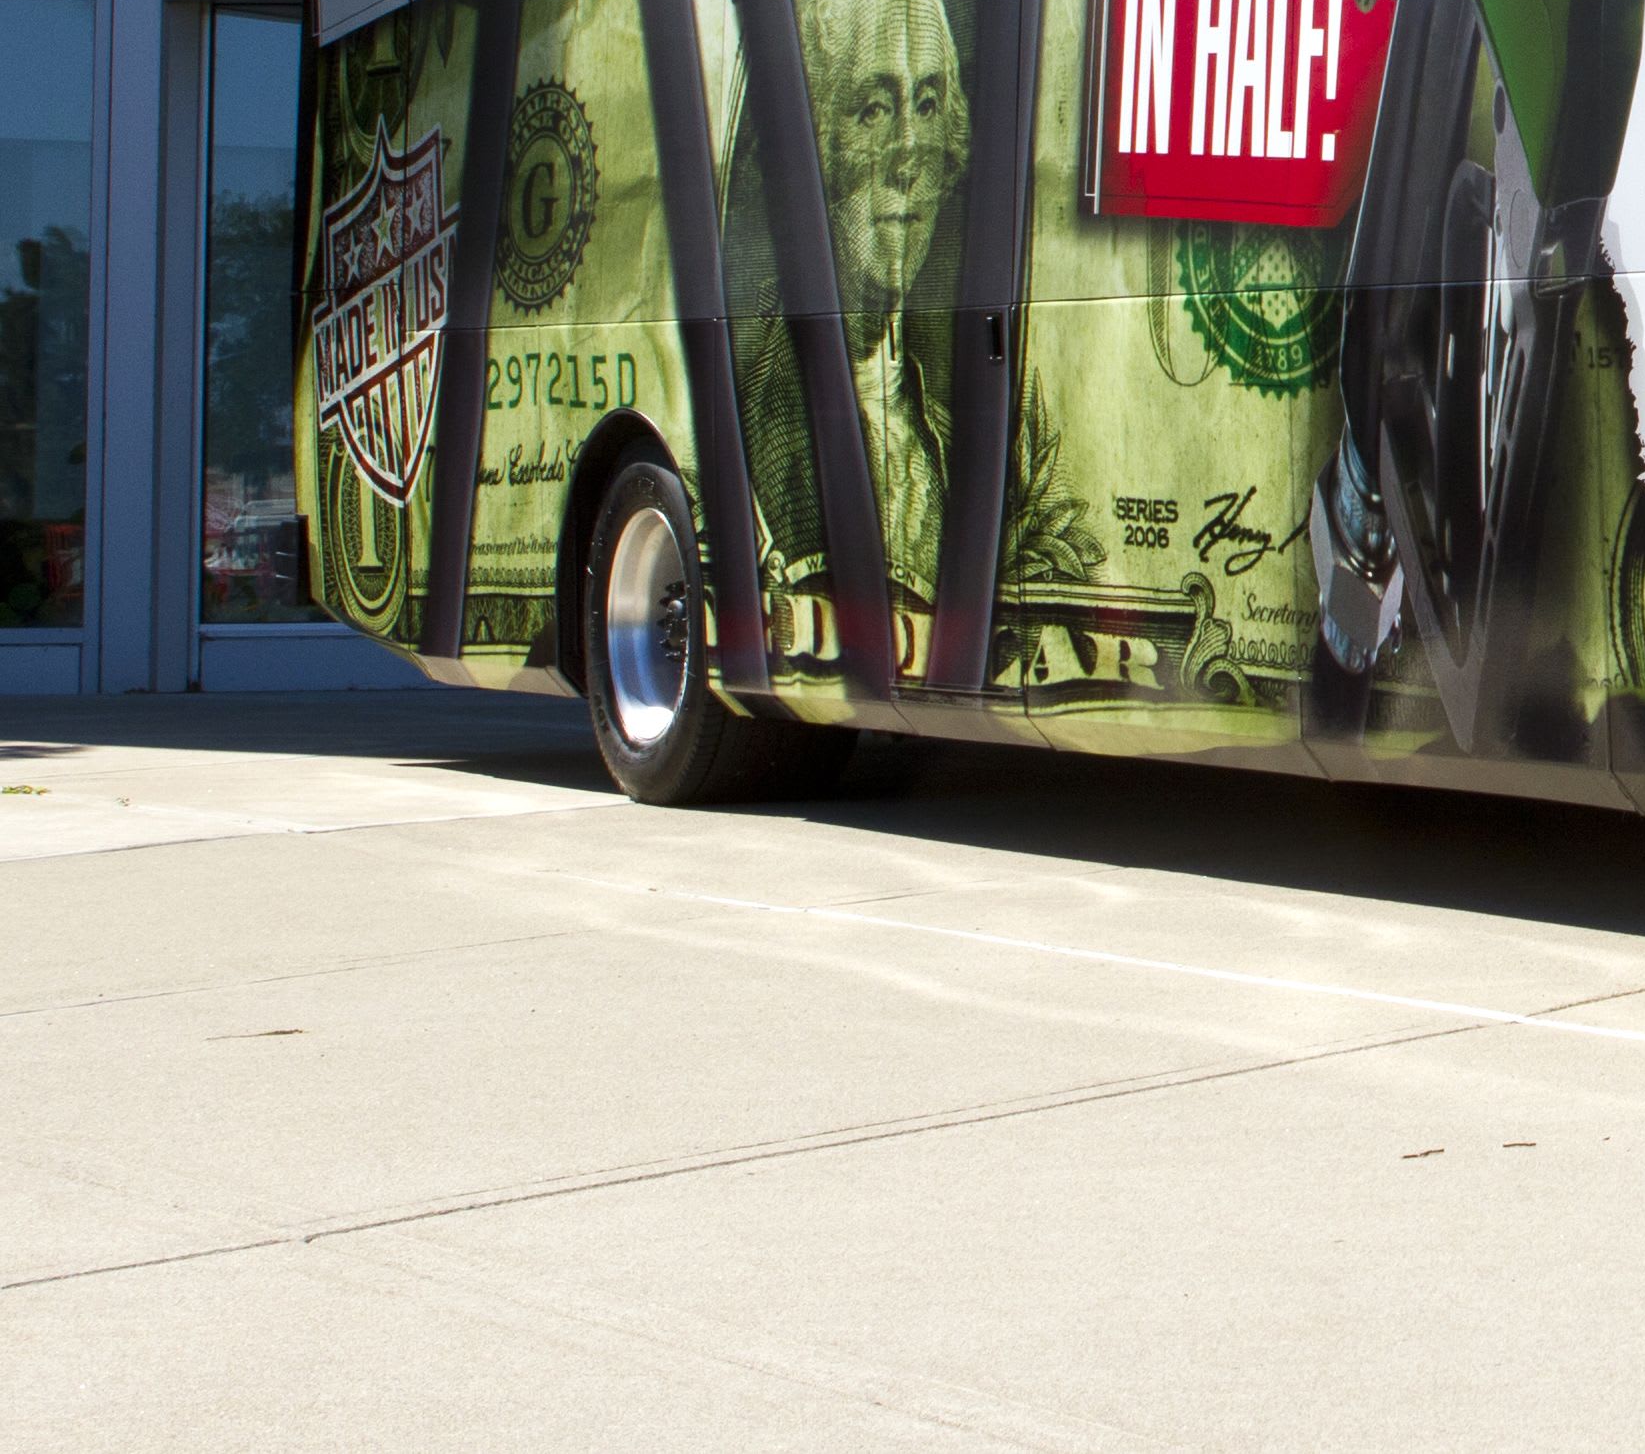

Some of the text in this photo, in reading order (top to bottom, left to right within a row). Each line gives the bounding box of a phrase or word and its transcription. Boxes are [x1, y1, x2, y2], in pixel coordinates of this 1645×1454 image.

[522, 161, 560, 238] G
[315, 291, 379, 403] MADE
[1115, 497, 1179, 524] SERIES
[1124, 525, 1170, 549] 2006
